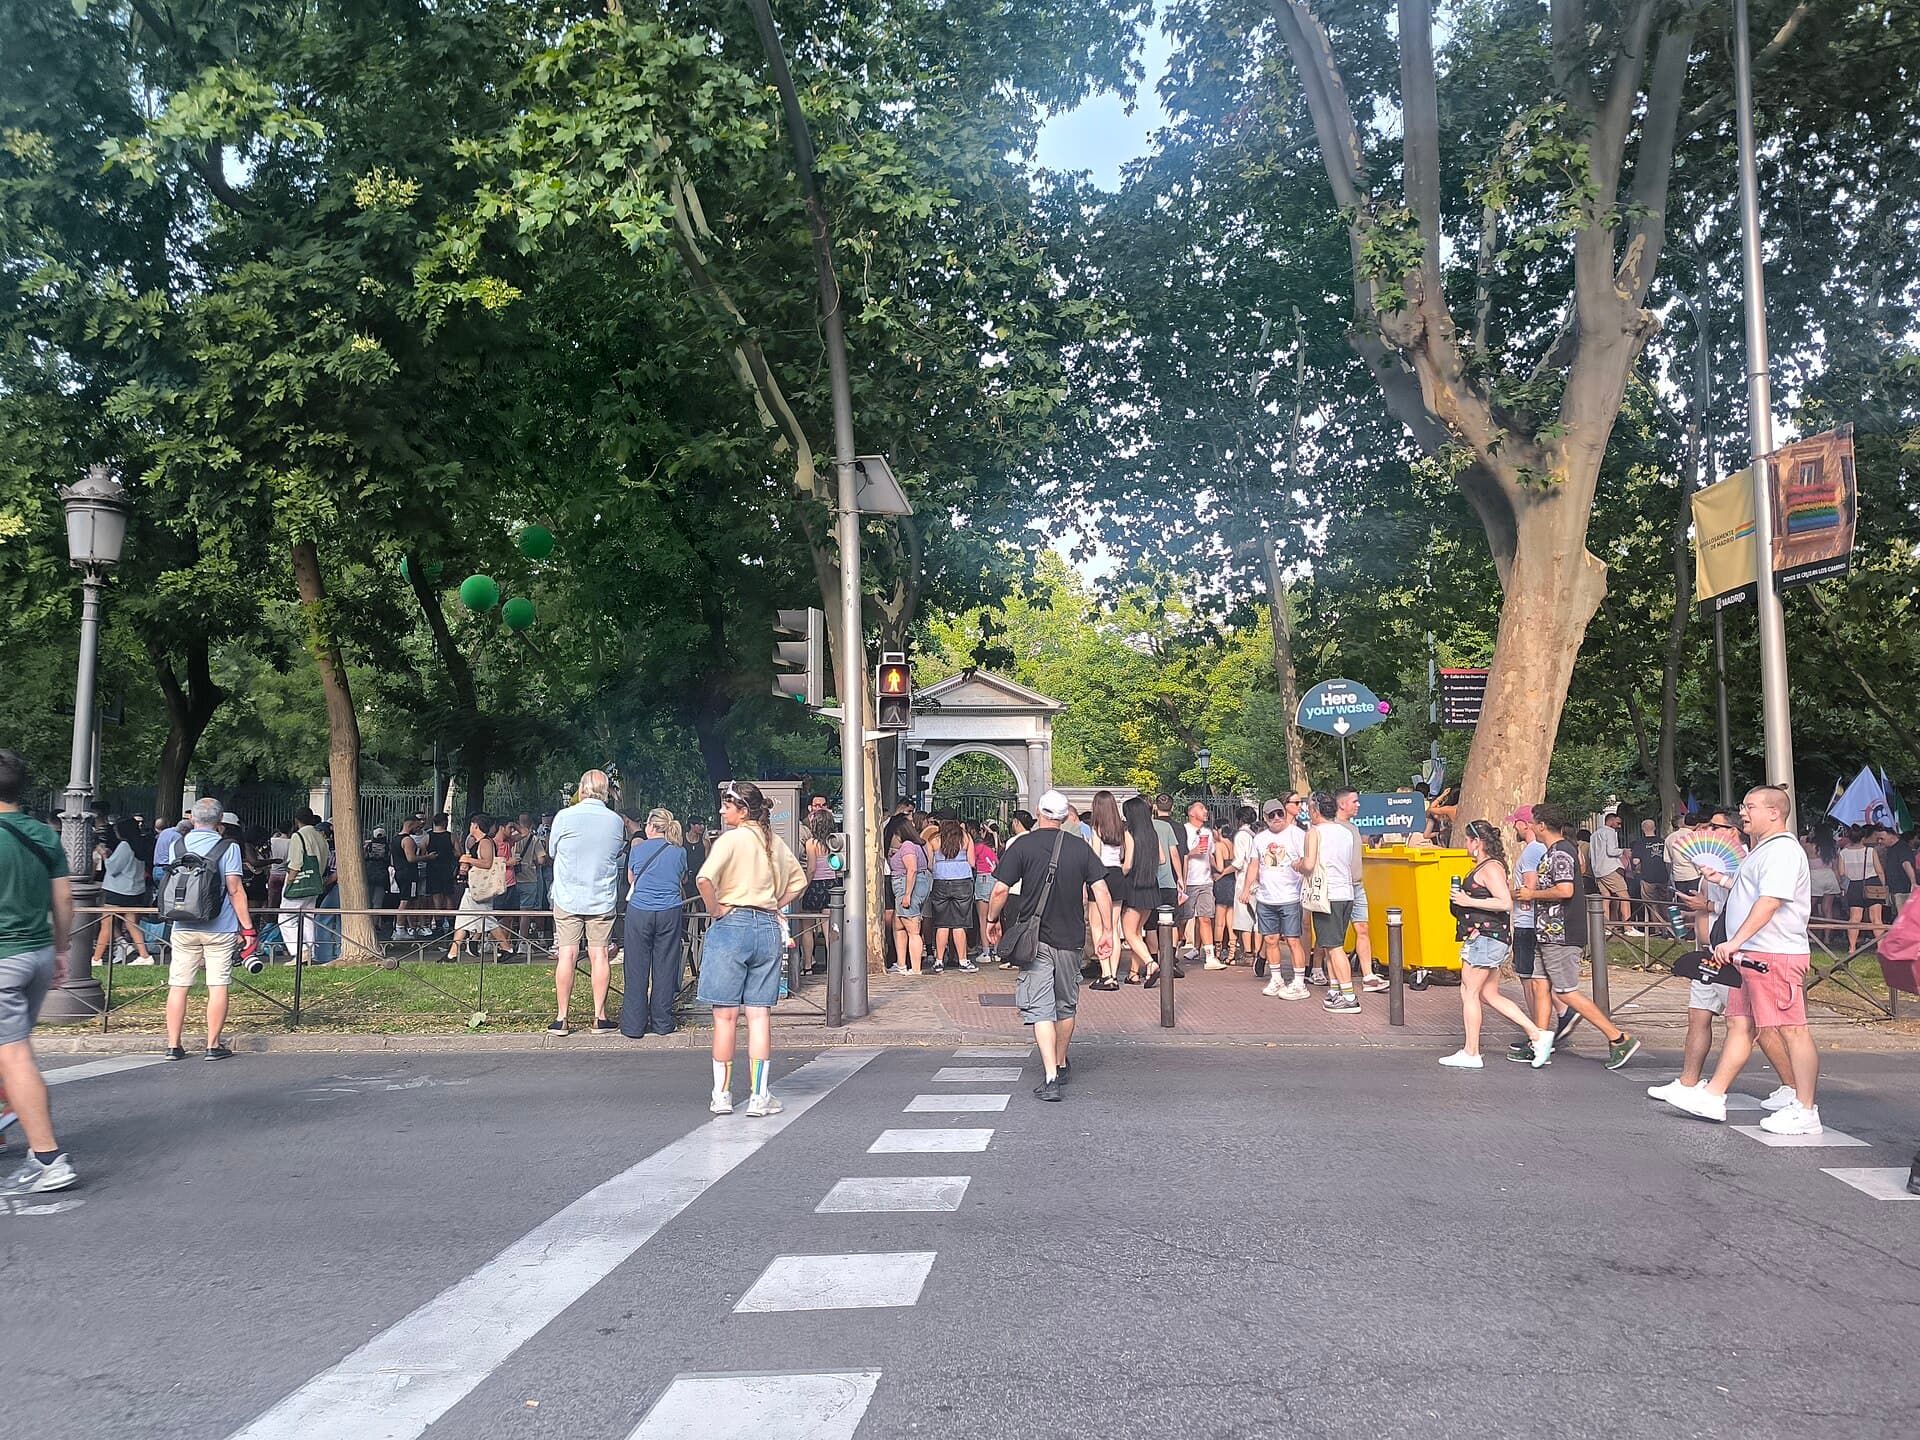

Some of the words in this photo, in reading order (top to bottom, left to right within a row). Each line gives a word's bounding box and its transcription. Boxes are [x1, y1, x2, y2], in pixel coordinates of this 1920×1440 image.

[1721, 592, 1746, 607] MADRID
[1321, 692, 1358, 706] Here
[1306, 705, 1335, 720] your
[1336, 702, 1375, 714] waste
[1386, 813, 1414, 829] dirty
